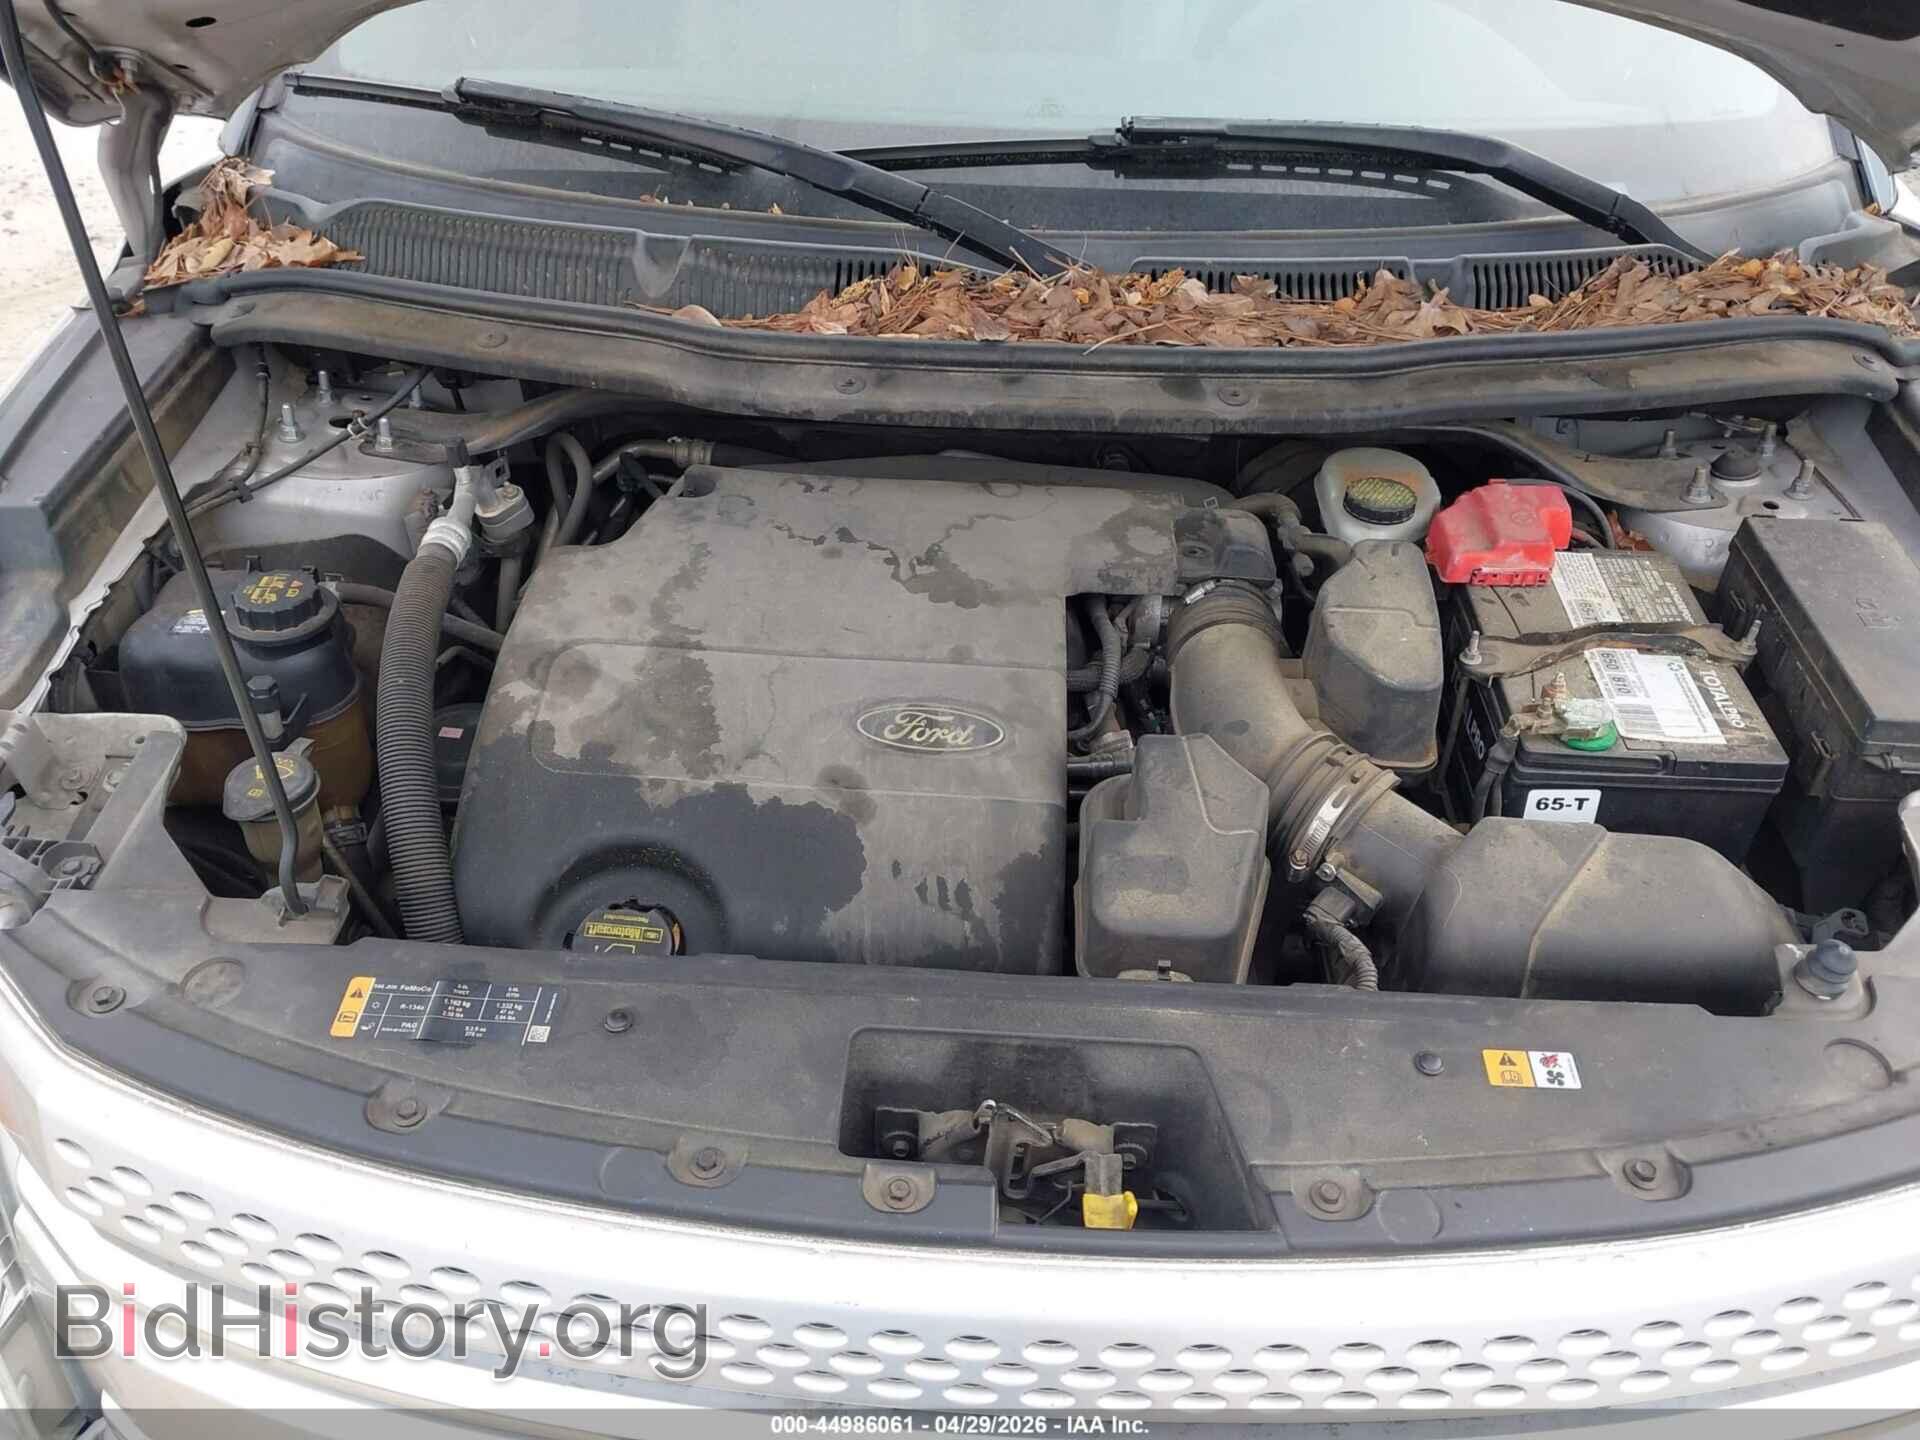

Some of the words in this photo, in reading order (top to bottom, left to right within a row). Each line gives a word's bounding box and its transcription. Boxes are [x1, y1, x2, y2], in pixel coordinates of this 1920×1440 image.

[1601, 652, 1619, 670] 650
[1613, 676, 1631, 695] 810
[1700, 669, 1745, 729] TOTALPRO
[884, 711, 976, 745] Ford
[1535, 797, 1590, 811] 65-T
